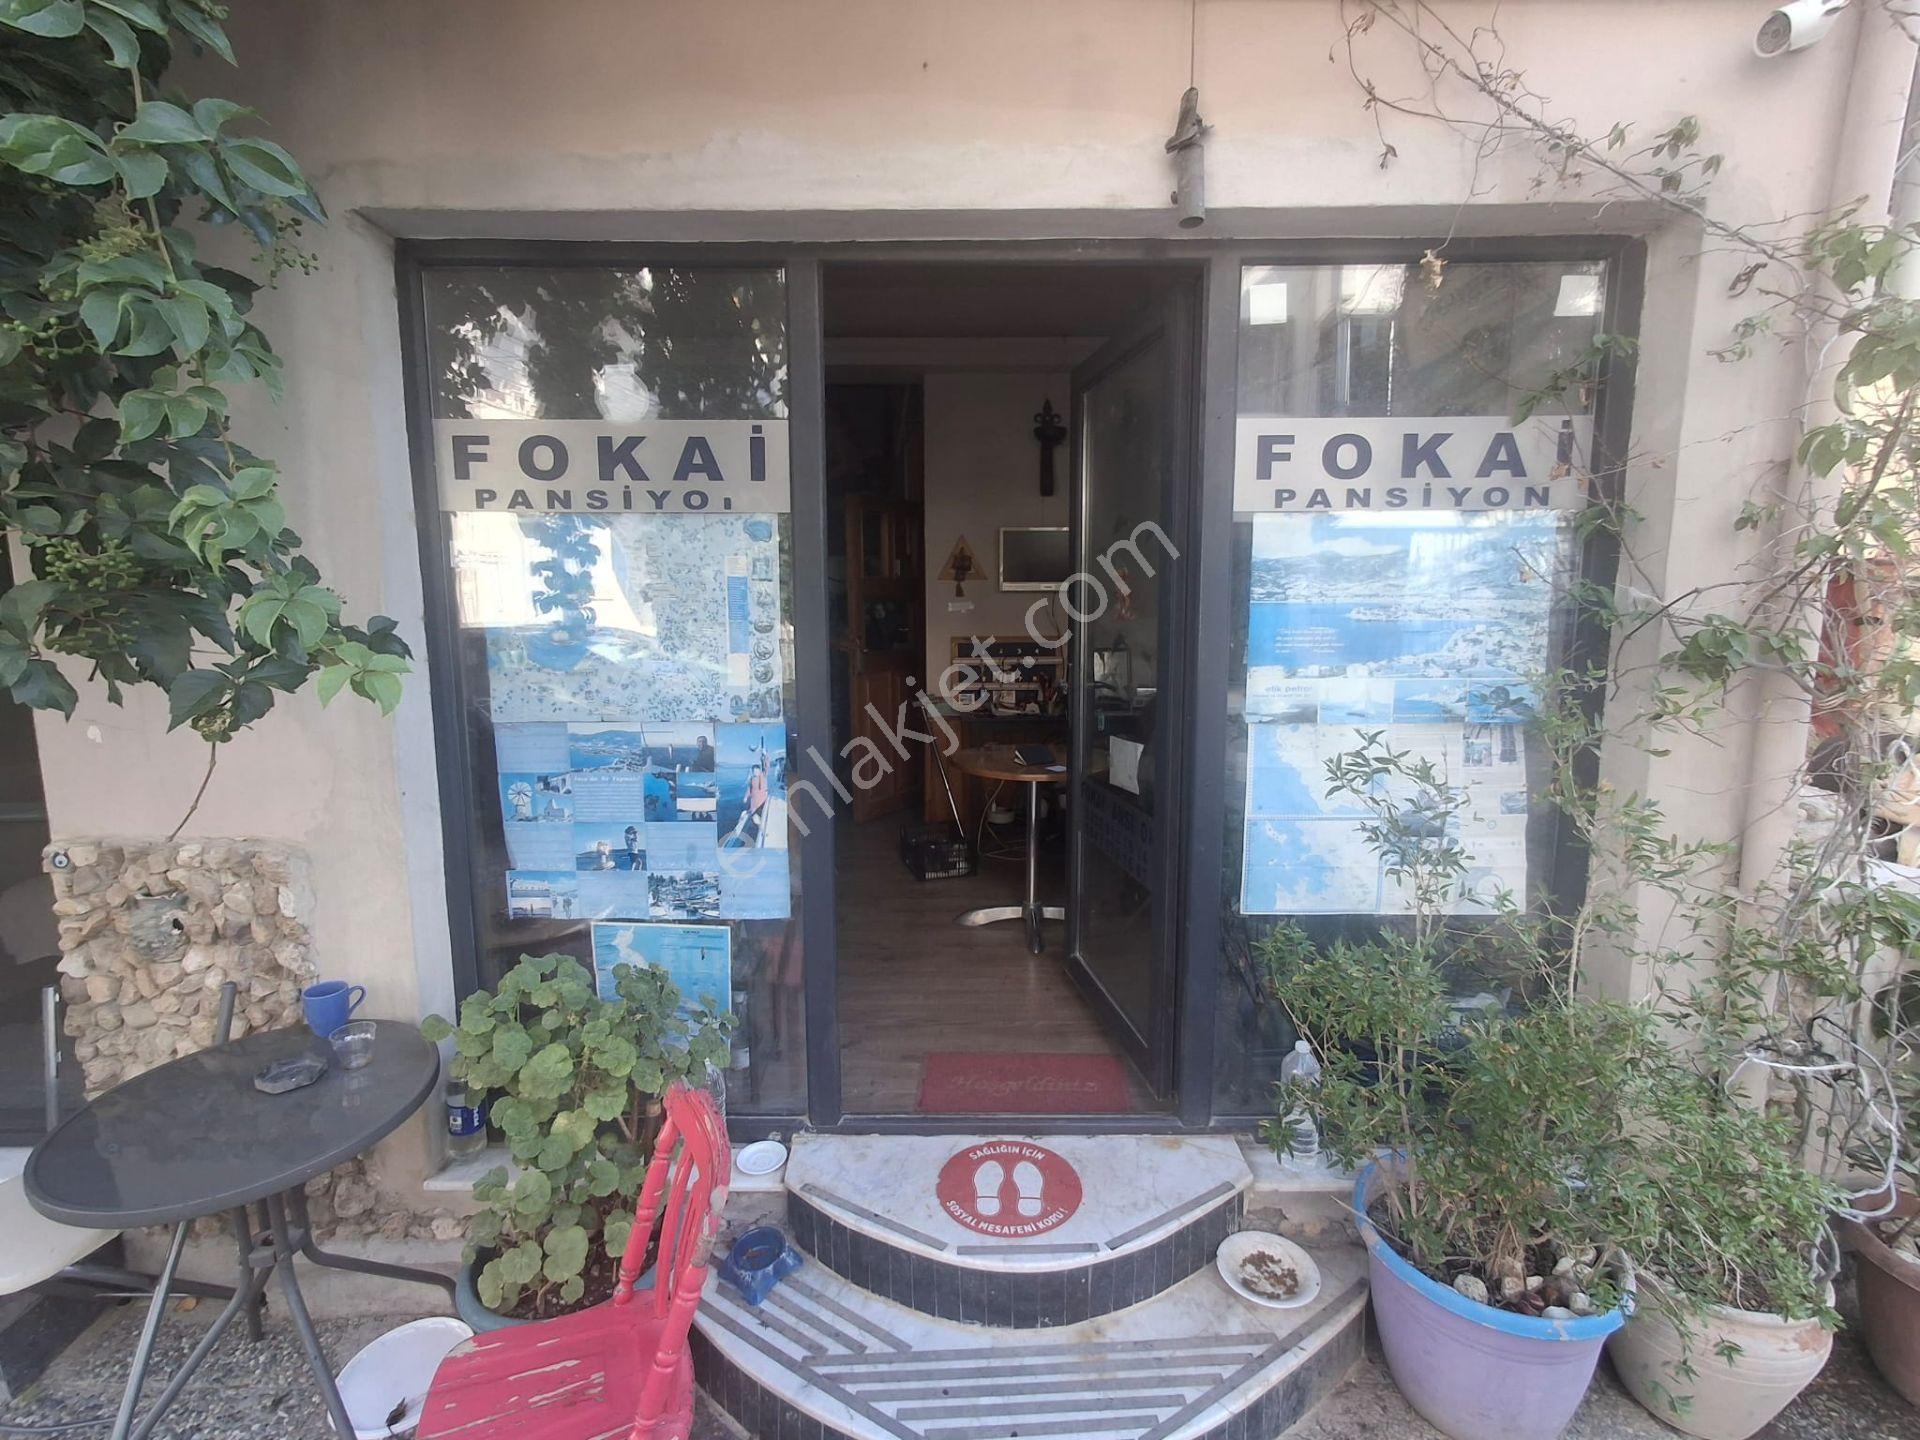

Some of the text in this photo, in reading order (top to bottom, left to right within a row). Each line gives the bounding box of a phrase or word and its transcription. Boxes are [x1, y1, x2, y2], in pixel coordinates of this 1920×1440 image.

[452, 425, 766, 482] FOKAİ
[1256, 419, 1574, 481] FOKAİ
[1274, 483, 1550, 509] PANSİYON
[969, 1144, 1045, 1161] SAĞLIĞIN İÇİN
[946, 1200, 977, 1226] SOSYAL
[978, 1220, 1037, 1234] MESAFENİ
